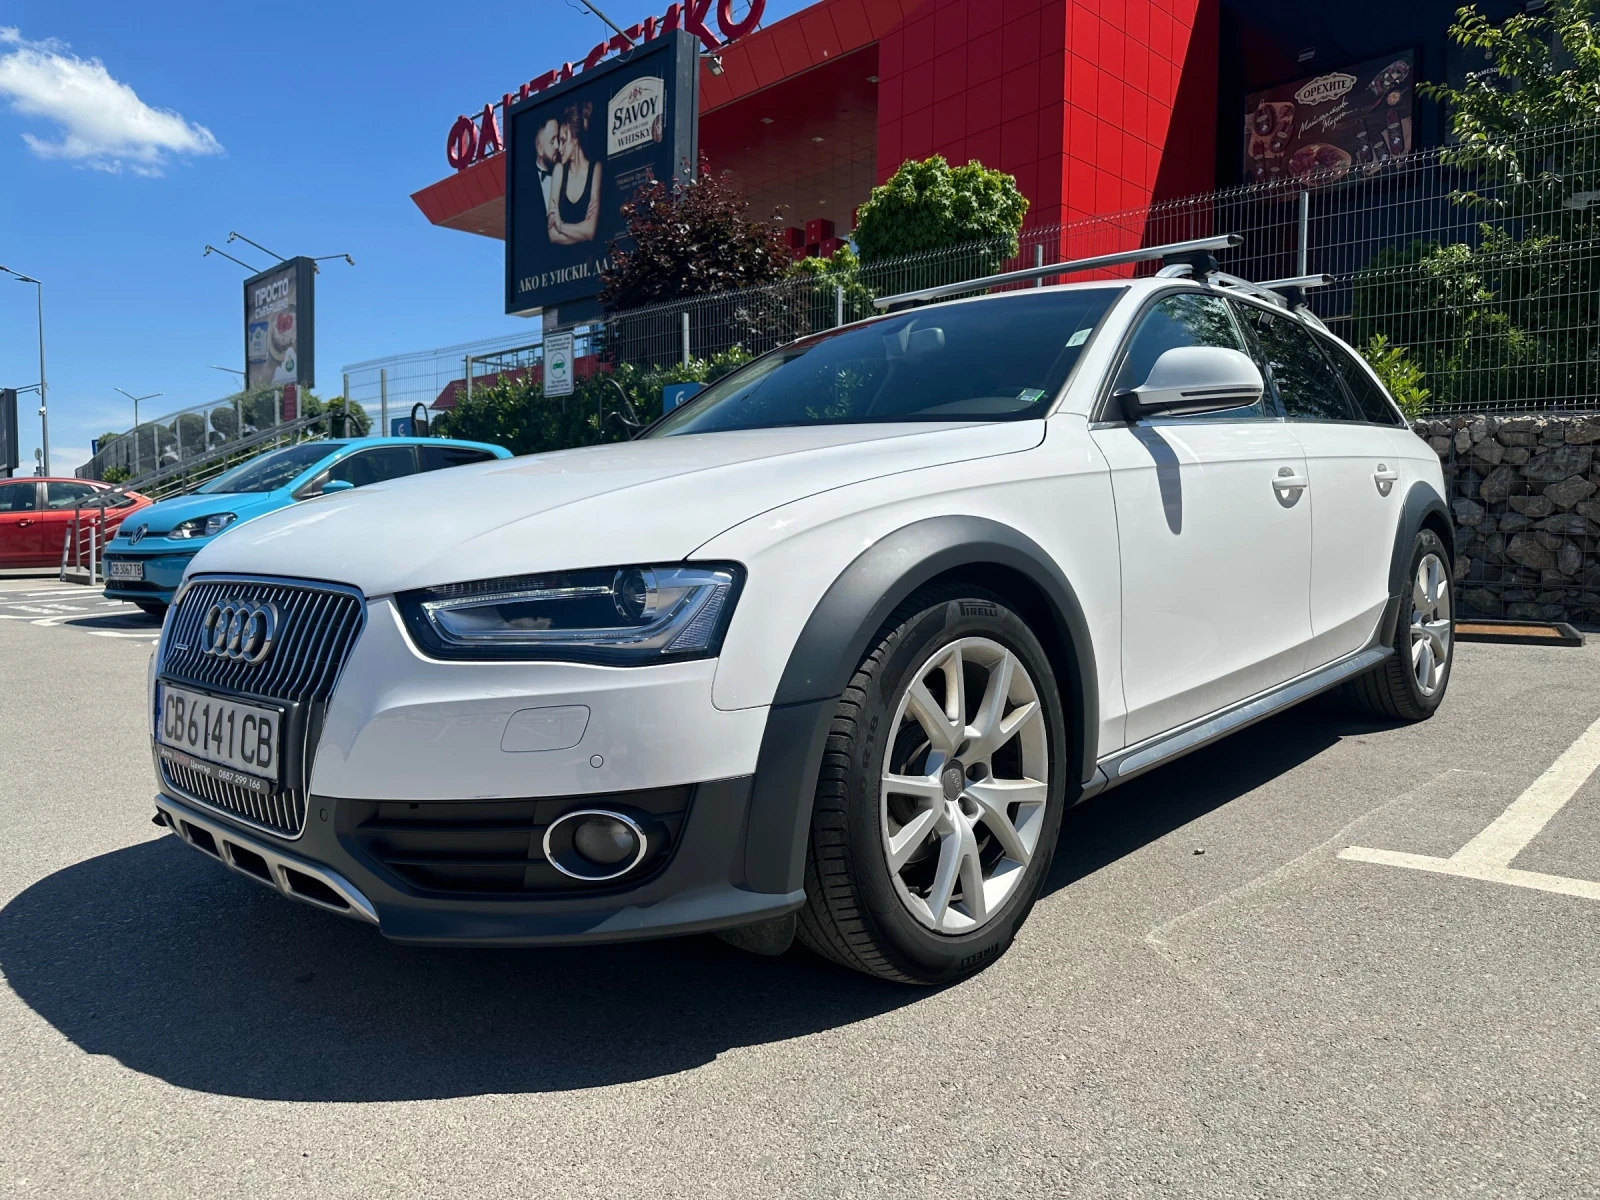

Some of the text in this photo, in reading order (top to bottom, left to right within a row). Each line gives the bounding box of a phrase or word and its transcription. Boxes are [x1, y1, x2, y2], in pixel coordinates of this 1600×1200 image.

[1473, 66, 1501, 79] AMESO
[447, 0, 766, 172] ФАСТИКО
[1303, 80, 1347, 99] ОРЕХИТЕ
[612, 95, 658, 135] SAVOY
[617, 126, 652, 147] WHISKY
[254, 278, 289, 308] ПРОСТО
[518, 276, 540, 293] АКО
[541, 273, 548, 288] Е
[958, 601, 998, 617] PIRELLI
[190, 760, 211, 774] Център
[218, 769, 234, 781] 0887
[234, 775, 247, 786] 299
[248, 778, 261, 790] 166
